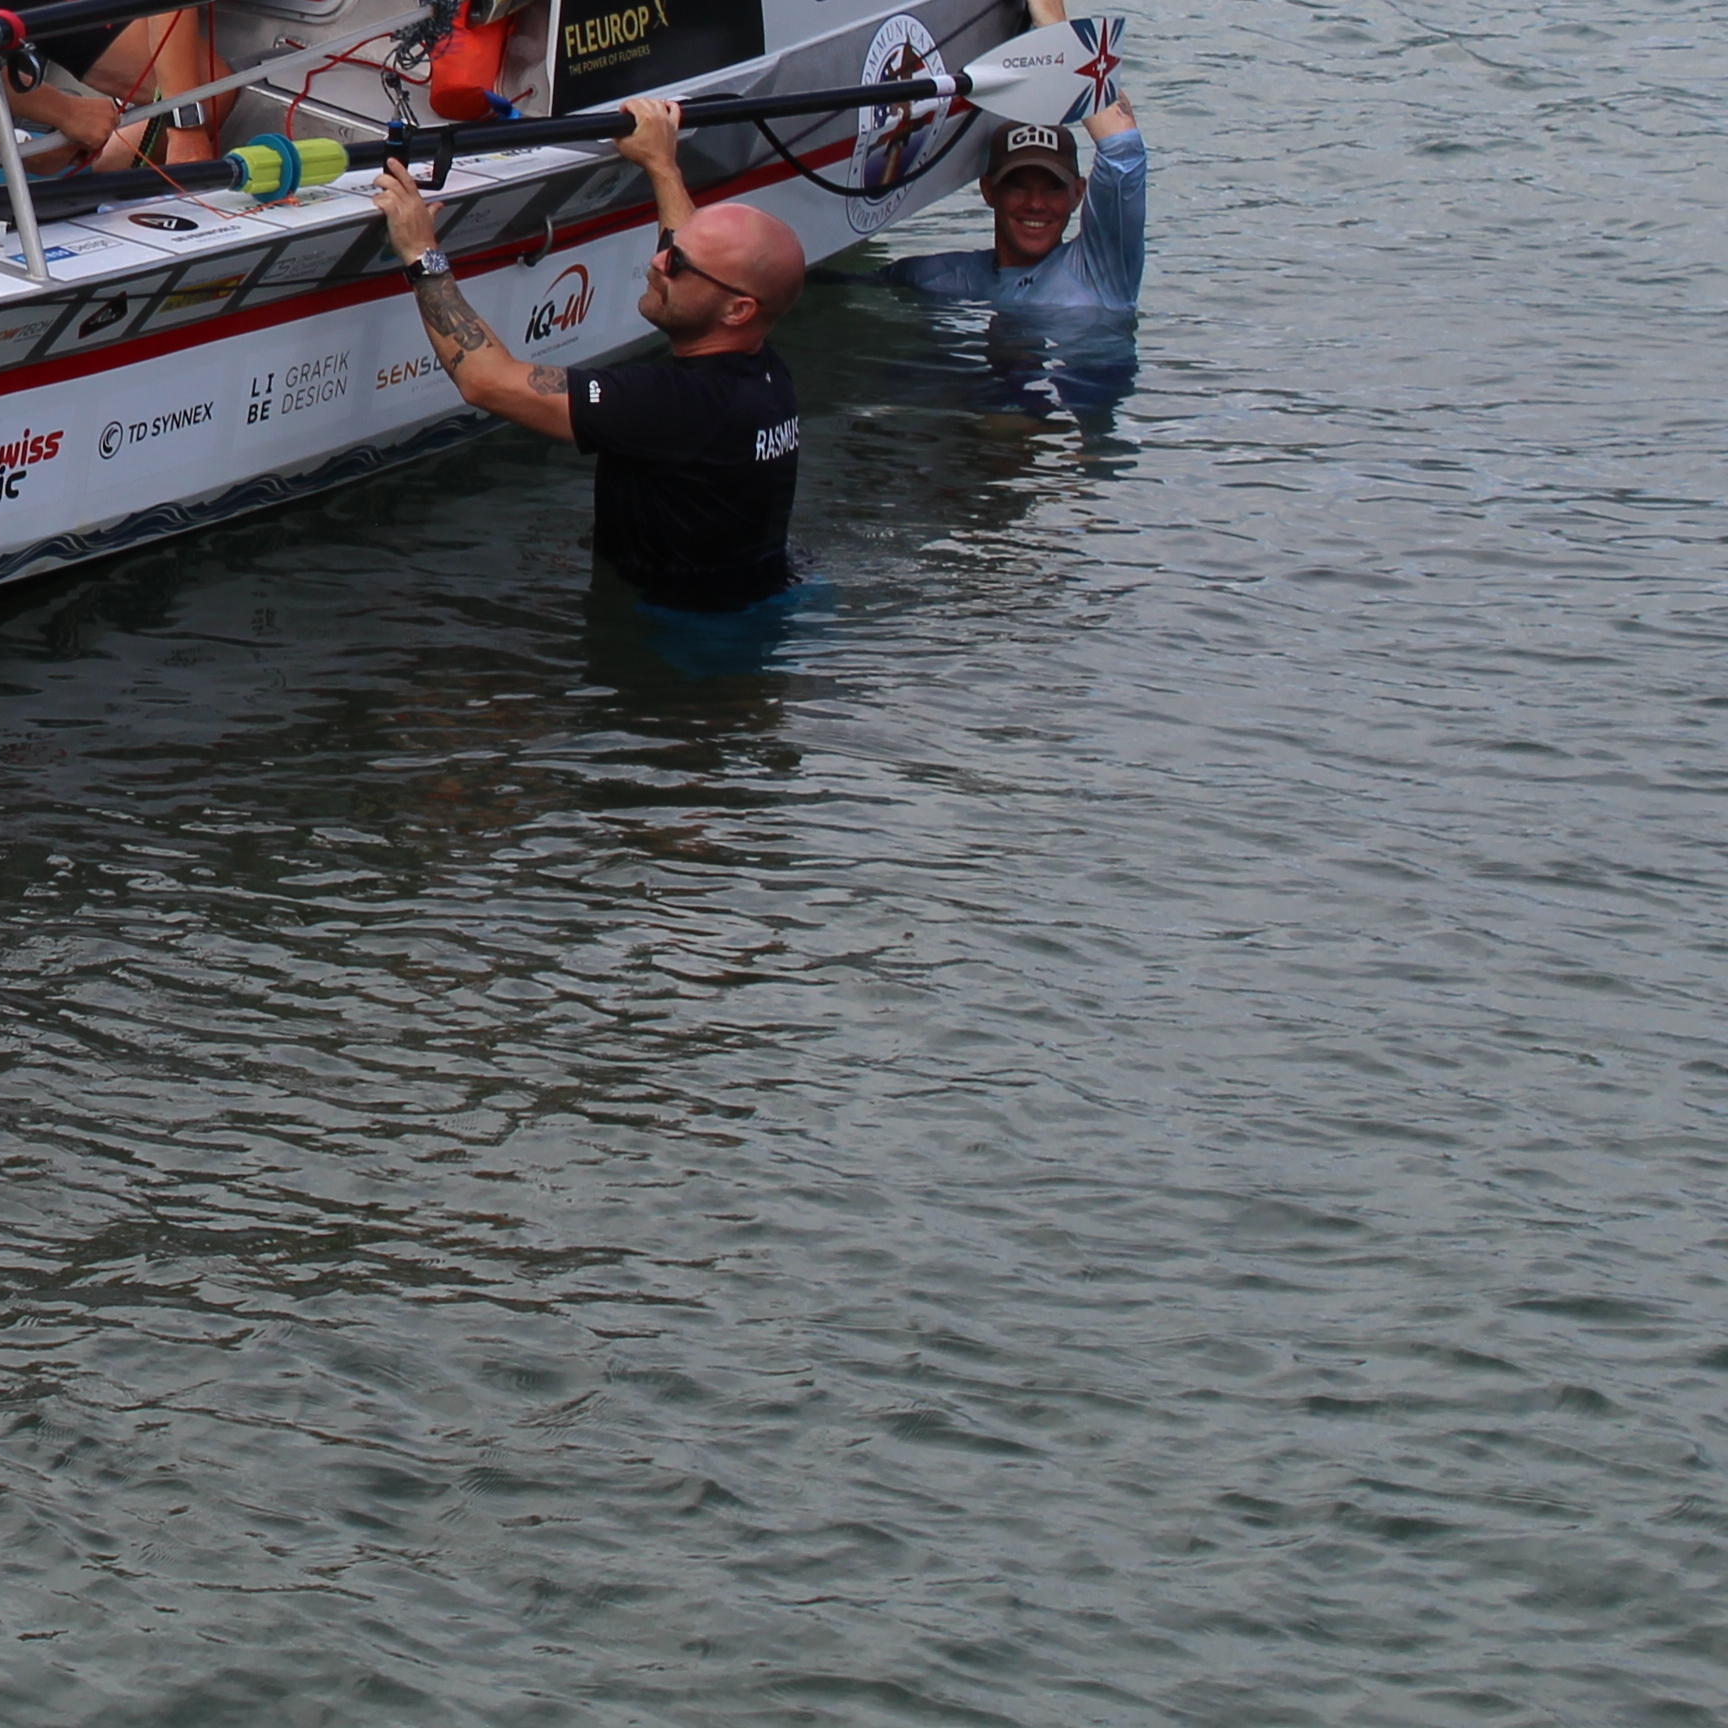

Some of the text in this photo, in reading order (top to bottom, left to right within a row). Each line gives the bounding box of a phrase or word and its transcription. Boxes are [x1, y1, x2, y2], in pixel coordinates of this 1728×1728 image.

[564, 5, 650, 59] FLEUROP
[1001, 50, 1066, 70] OCEAN'S 4
[1011, 125, 1054, 147] Gill
[285, 349, 351, 389] GRAFIK
[245, 398, 272, 427] BE
[280, 375, 349, 415] DESIGN
[128, 400, 214, 445] TD SYNNEX
